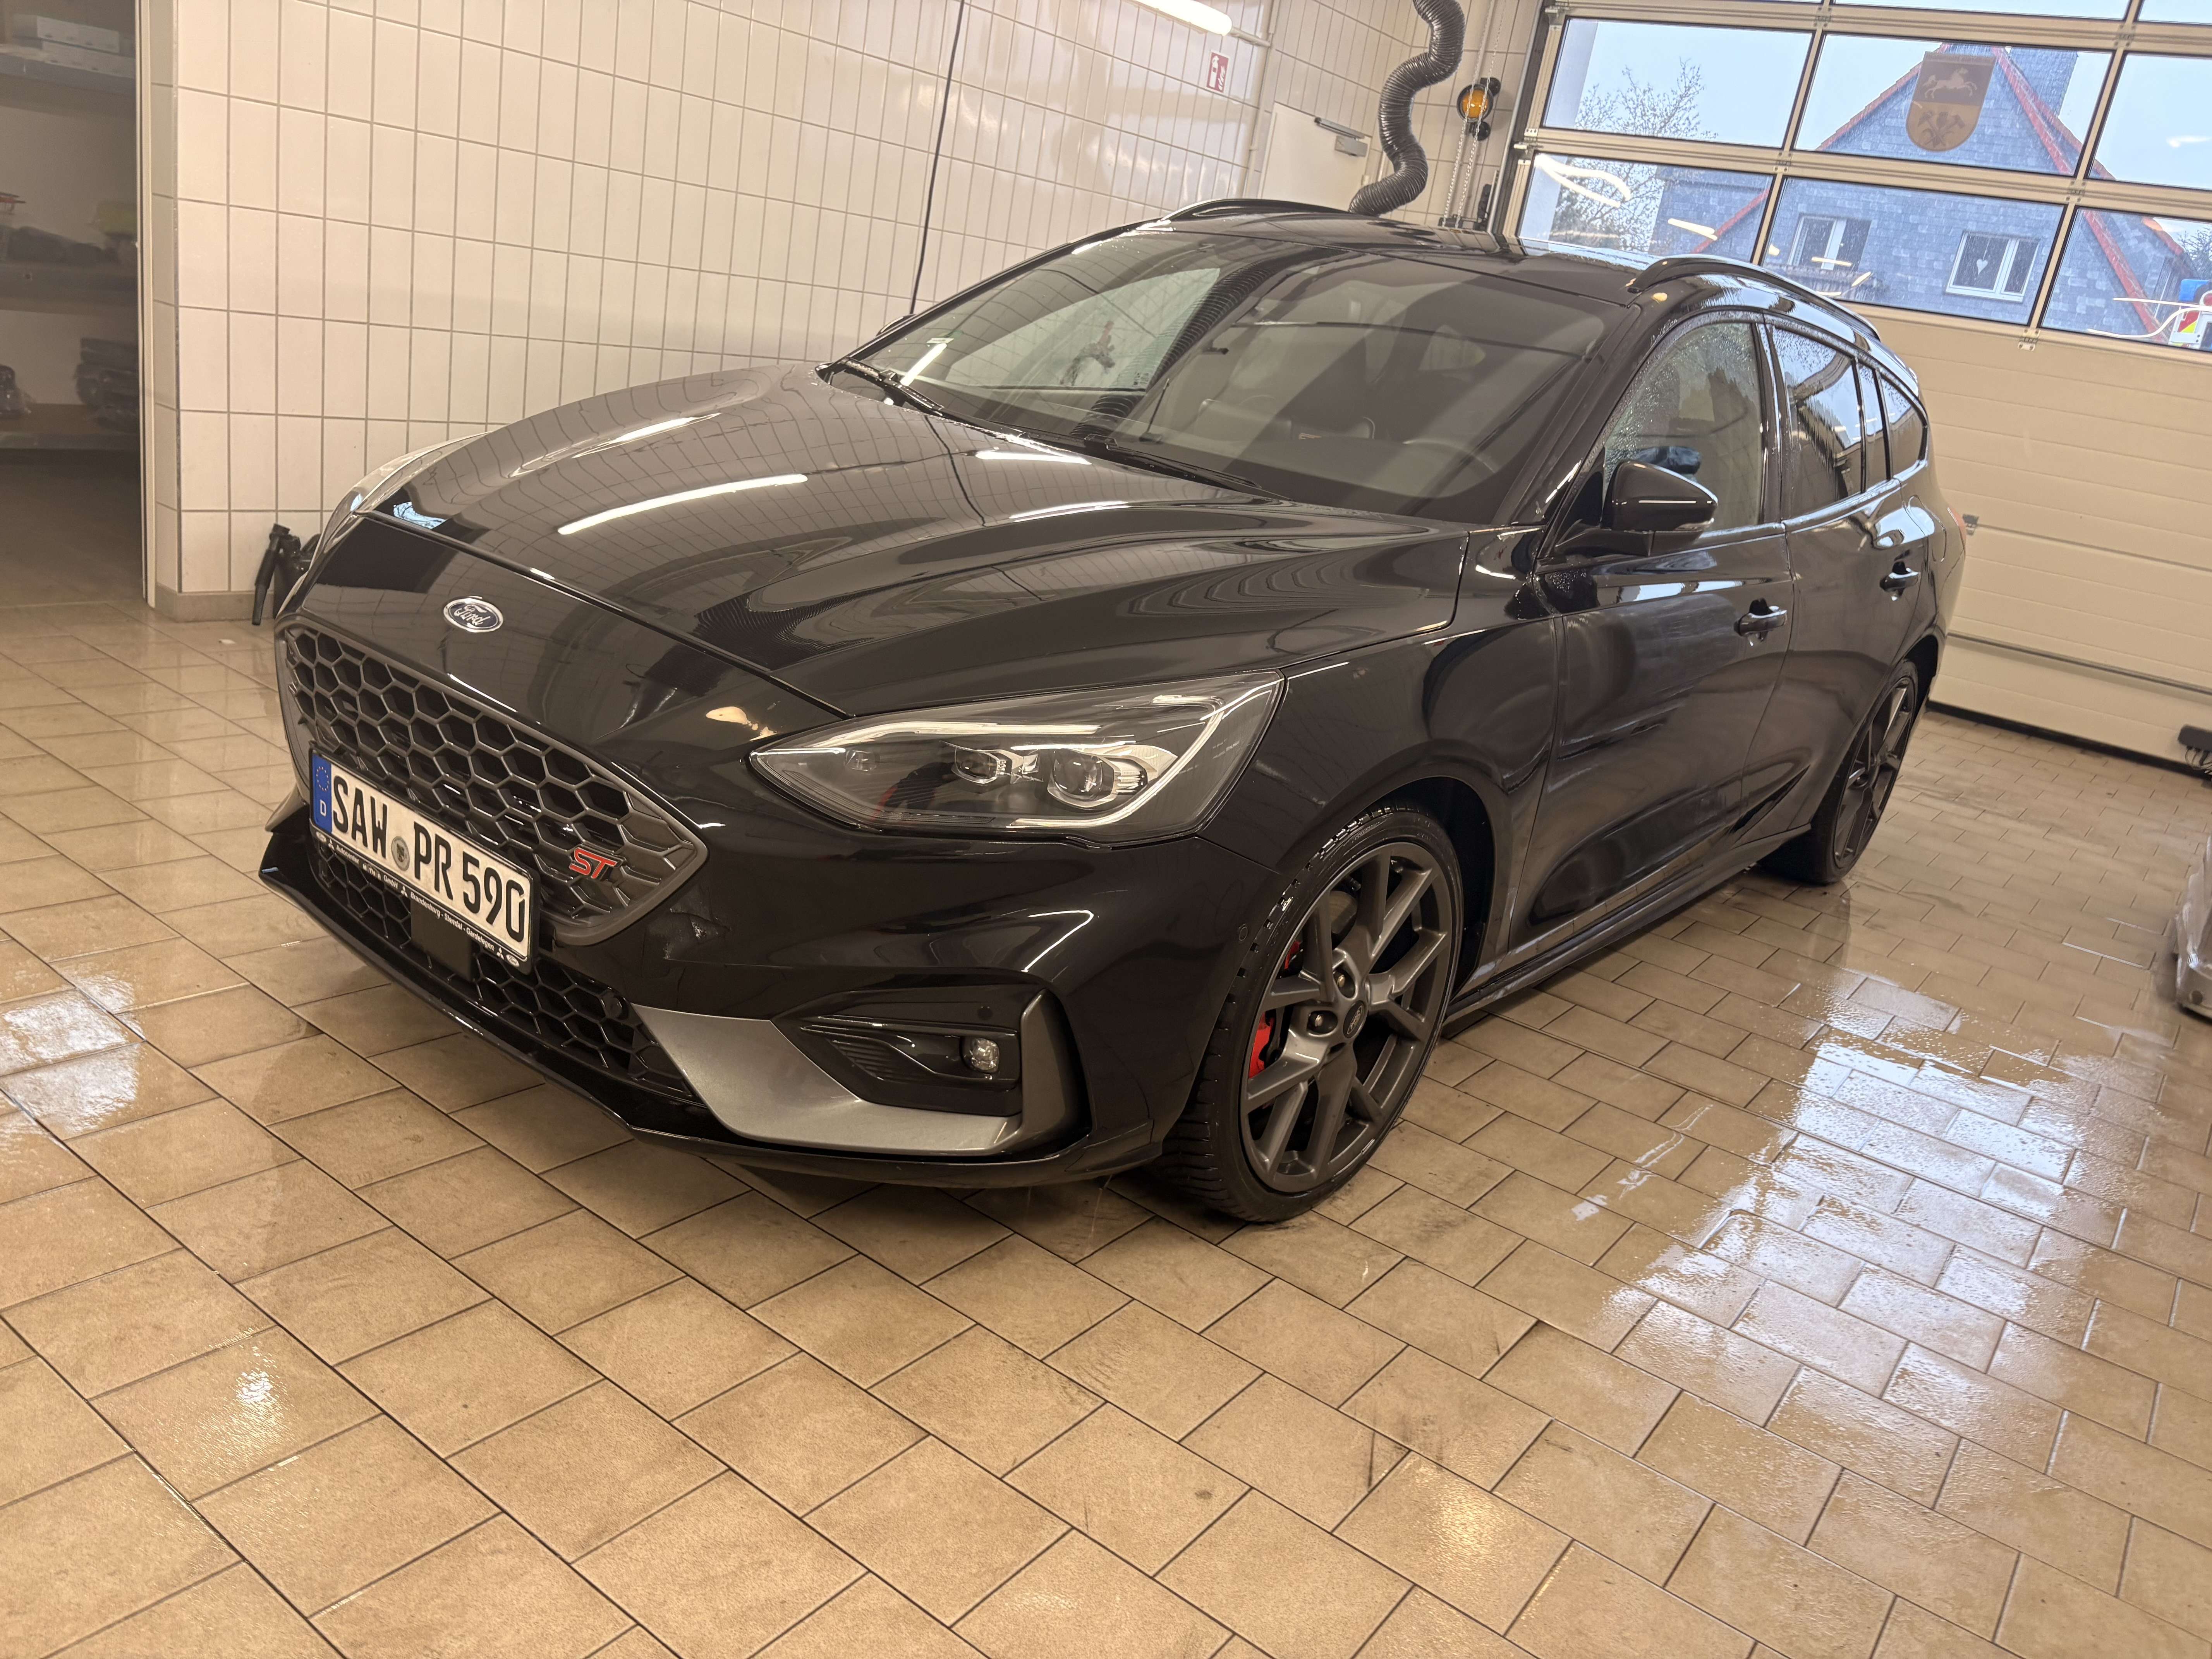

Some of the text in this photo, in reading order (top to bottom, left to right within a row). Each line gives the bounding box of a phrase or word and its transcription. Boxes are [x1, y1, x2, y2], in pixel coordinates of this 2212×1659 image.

[454, 604, 491, 626] Ford
[319, 799, 326, 817] D
[333, 775, 525, 943] SAW PR 590
[568, 847, 618, 879] ST
[383, 874, 398, 890] GmbH
[410, 891, 441, 920] Brandenburg
[444, 913, 463, 930] Stendal
[466, 927, 495, 951] Gardelegen
